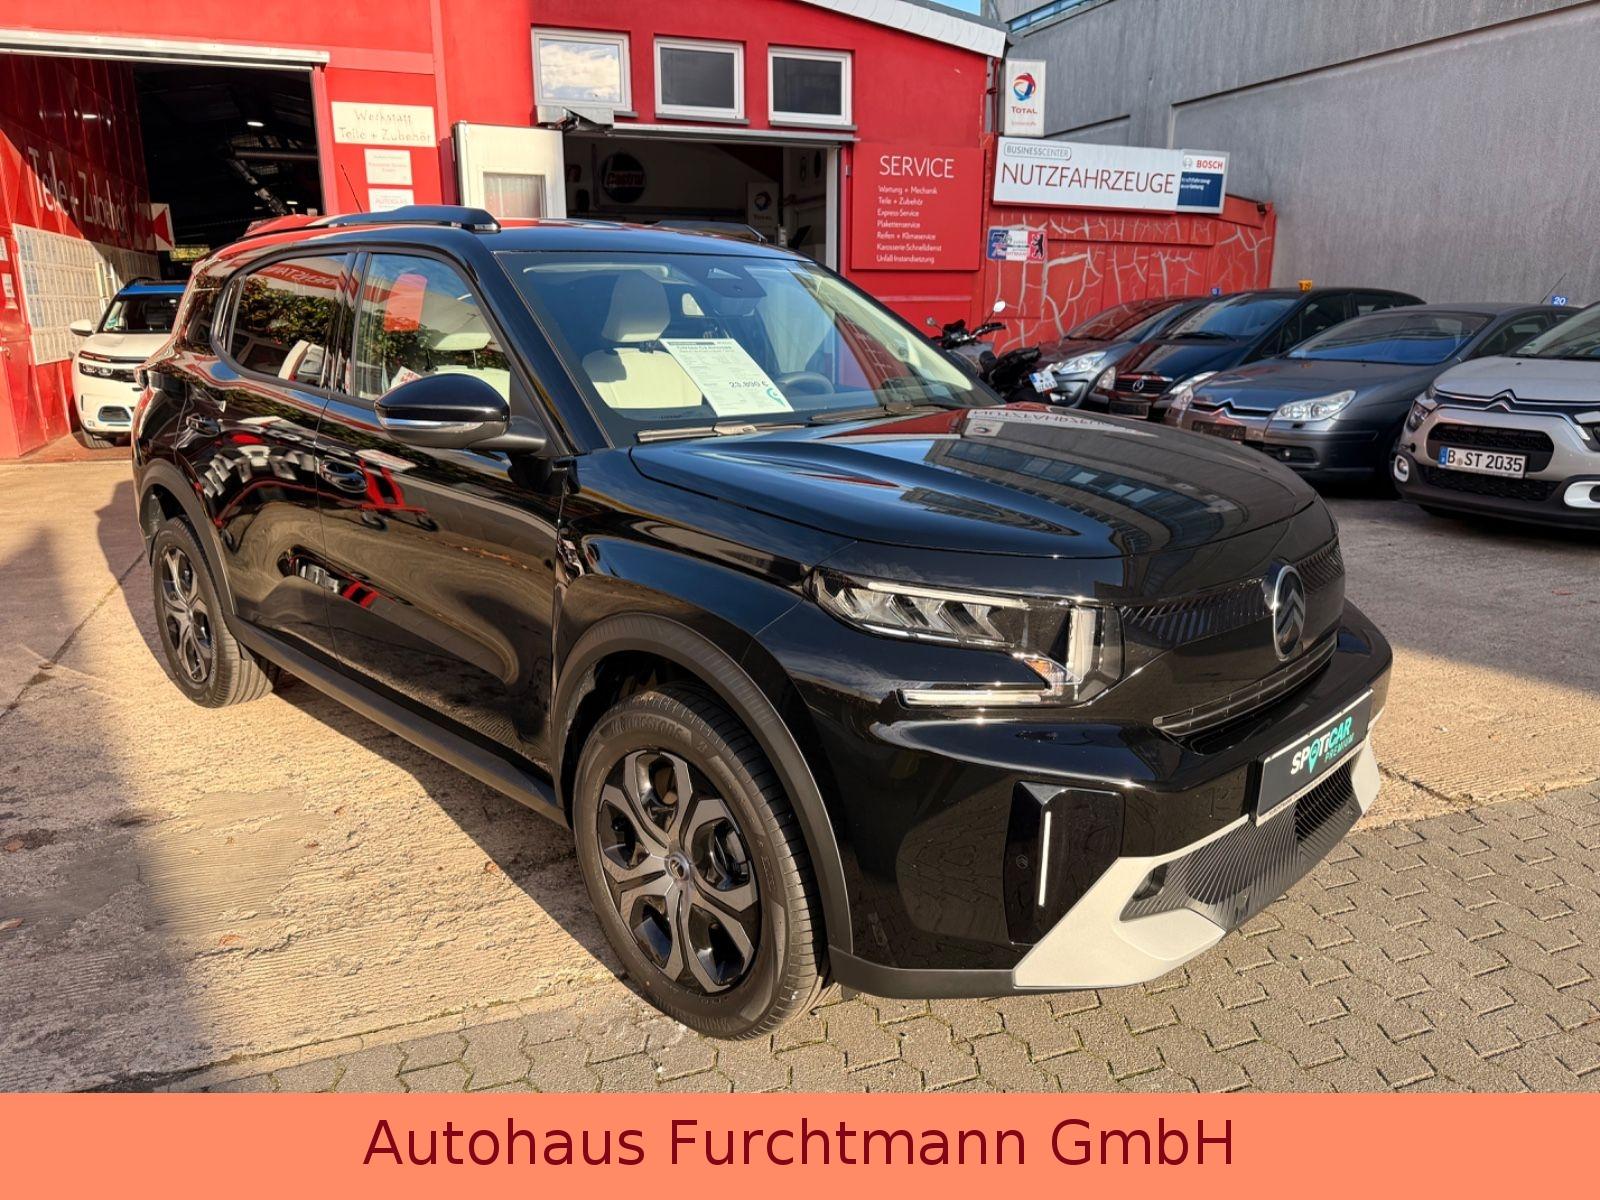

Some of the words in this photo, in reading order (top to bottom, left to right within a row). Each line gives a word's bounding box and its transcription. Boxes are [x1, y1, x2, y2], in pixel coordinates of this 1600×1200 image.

[1011, 106, 1037, 114] TOTAL
[1006, 145, 1070, 158] BUSINESSCENTER
[879, 155, 955, 179] SERVICE
[1196, 159, 1223, 169] BOSCH
[1001, 163, 1176, 195] NUTZFAHRZEUGE
[878, 185, 902, 195] Wartung
[910, 186, 938, 195] Mechanik
[1553, 296, 1566, 306] 20
[1448, 449, 1457, 465] B
[1464, 452, 1483, 468] ST
[1485, 454, 1524, 473] 2035
